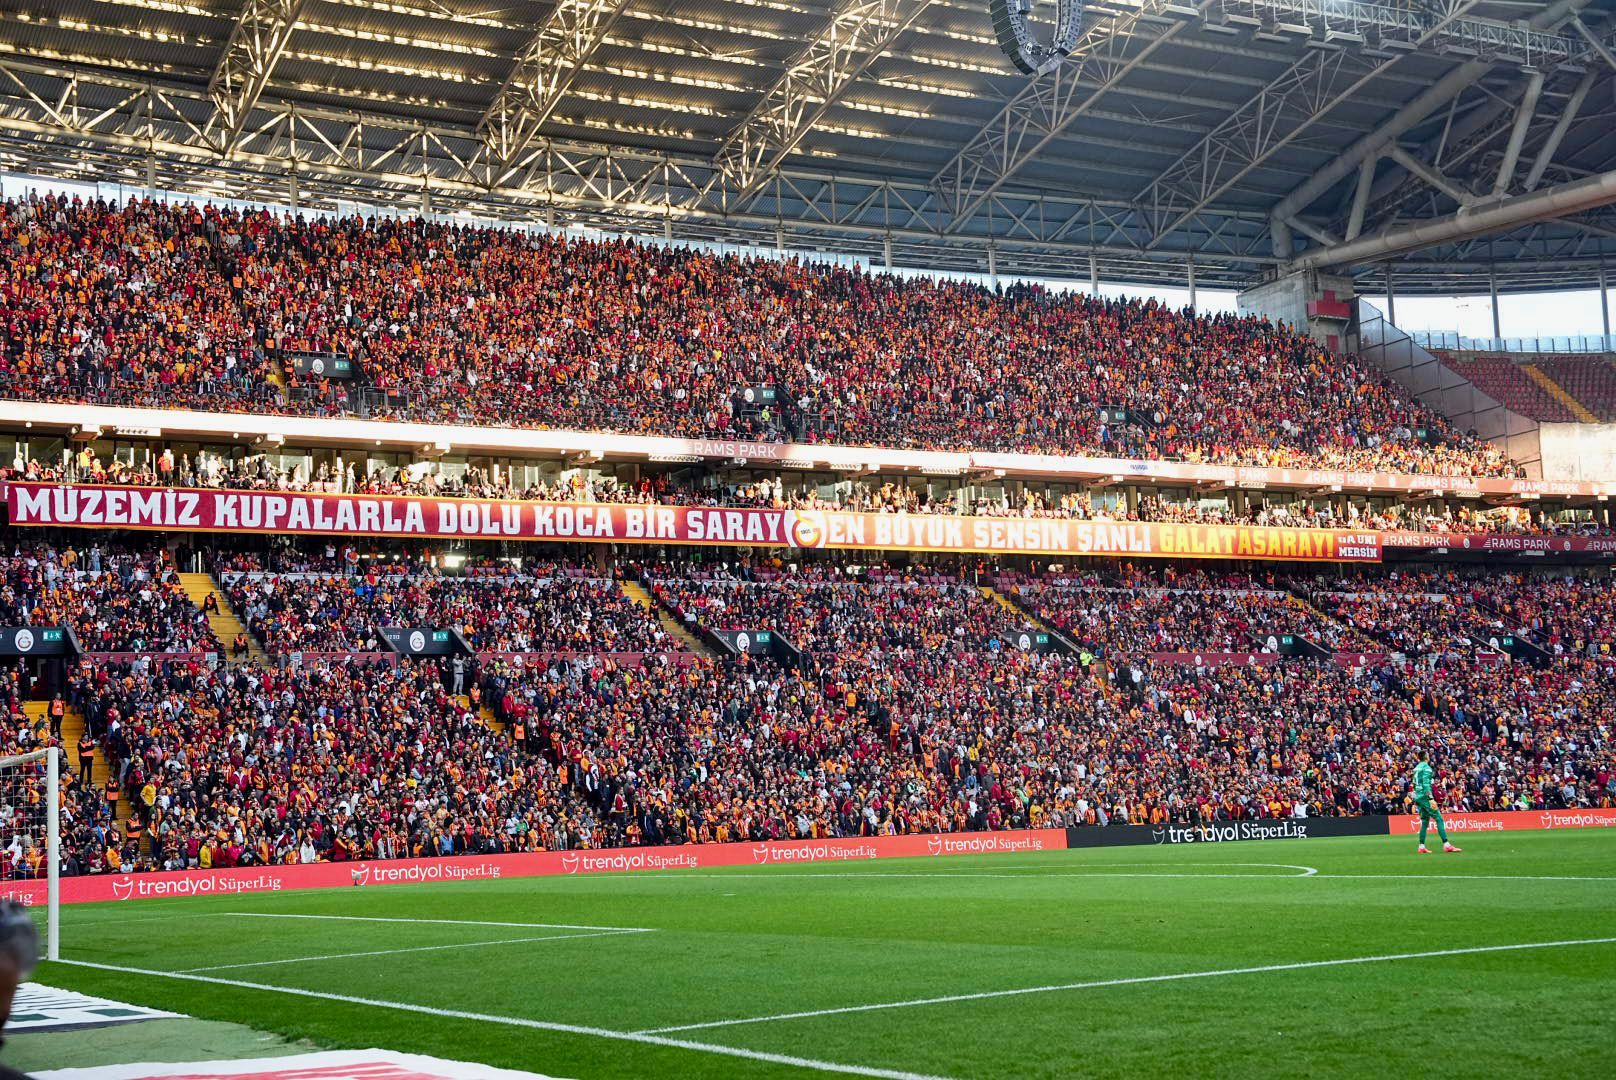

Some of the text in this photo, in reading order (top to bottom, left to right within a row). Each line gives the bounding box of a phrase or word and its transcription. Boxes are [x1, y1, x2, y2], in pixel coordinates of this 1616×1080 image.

[694, 442, 777, 457] RAMS PARK
[1347, 473, 1376, 486] PARK
[1520, 481, 1548, 492] RAMS
[15, 485, 200, 525] MÜZEMİZ
[214, 495, 426, 532] KUPALARLA
[437, 502, 522, 536] DOLU
[534, 505, 617, 538] KOCA
[625, 506, 676, 539] BİR
[687, 510, 782, 542] SARAY
[828, 515, 865, 546] EN
[1159, 526, 1334, 557] GALATASARAY!
[1390, 535, 1451, 547] RAMS PARK
[1492, 538, 1551, 550] RAMS PARK
[1427, 818, 1503, 832] redyol SüperLig
[1554, 813, 1594, 827] trendyol
[1169, 821, 1307, 843] trendyol SüperLig
[945, 837, 1043, 852] trendyol SüperLig
[771, 844, 877, 861] trendyol SüperLig
[583, 853, 697, 871] trendyol SüperLig
[373, 863, 501, 882] trendyol SüperLig
[138, 875, 282, 896] trendyol SüperLig
